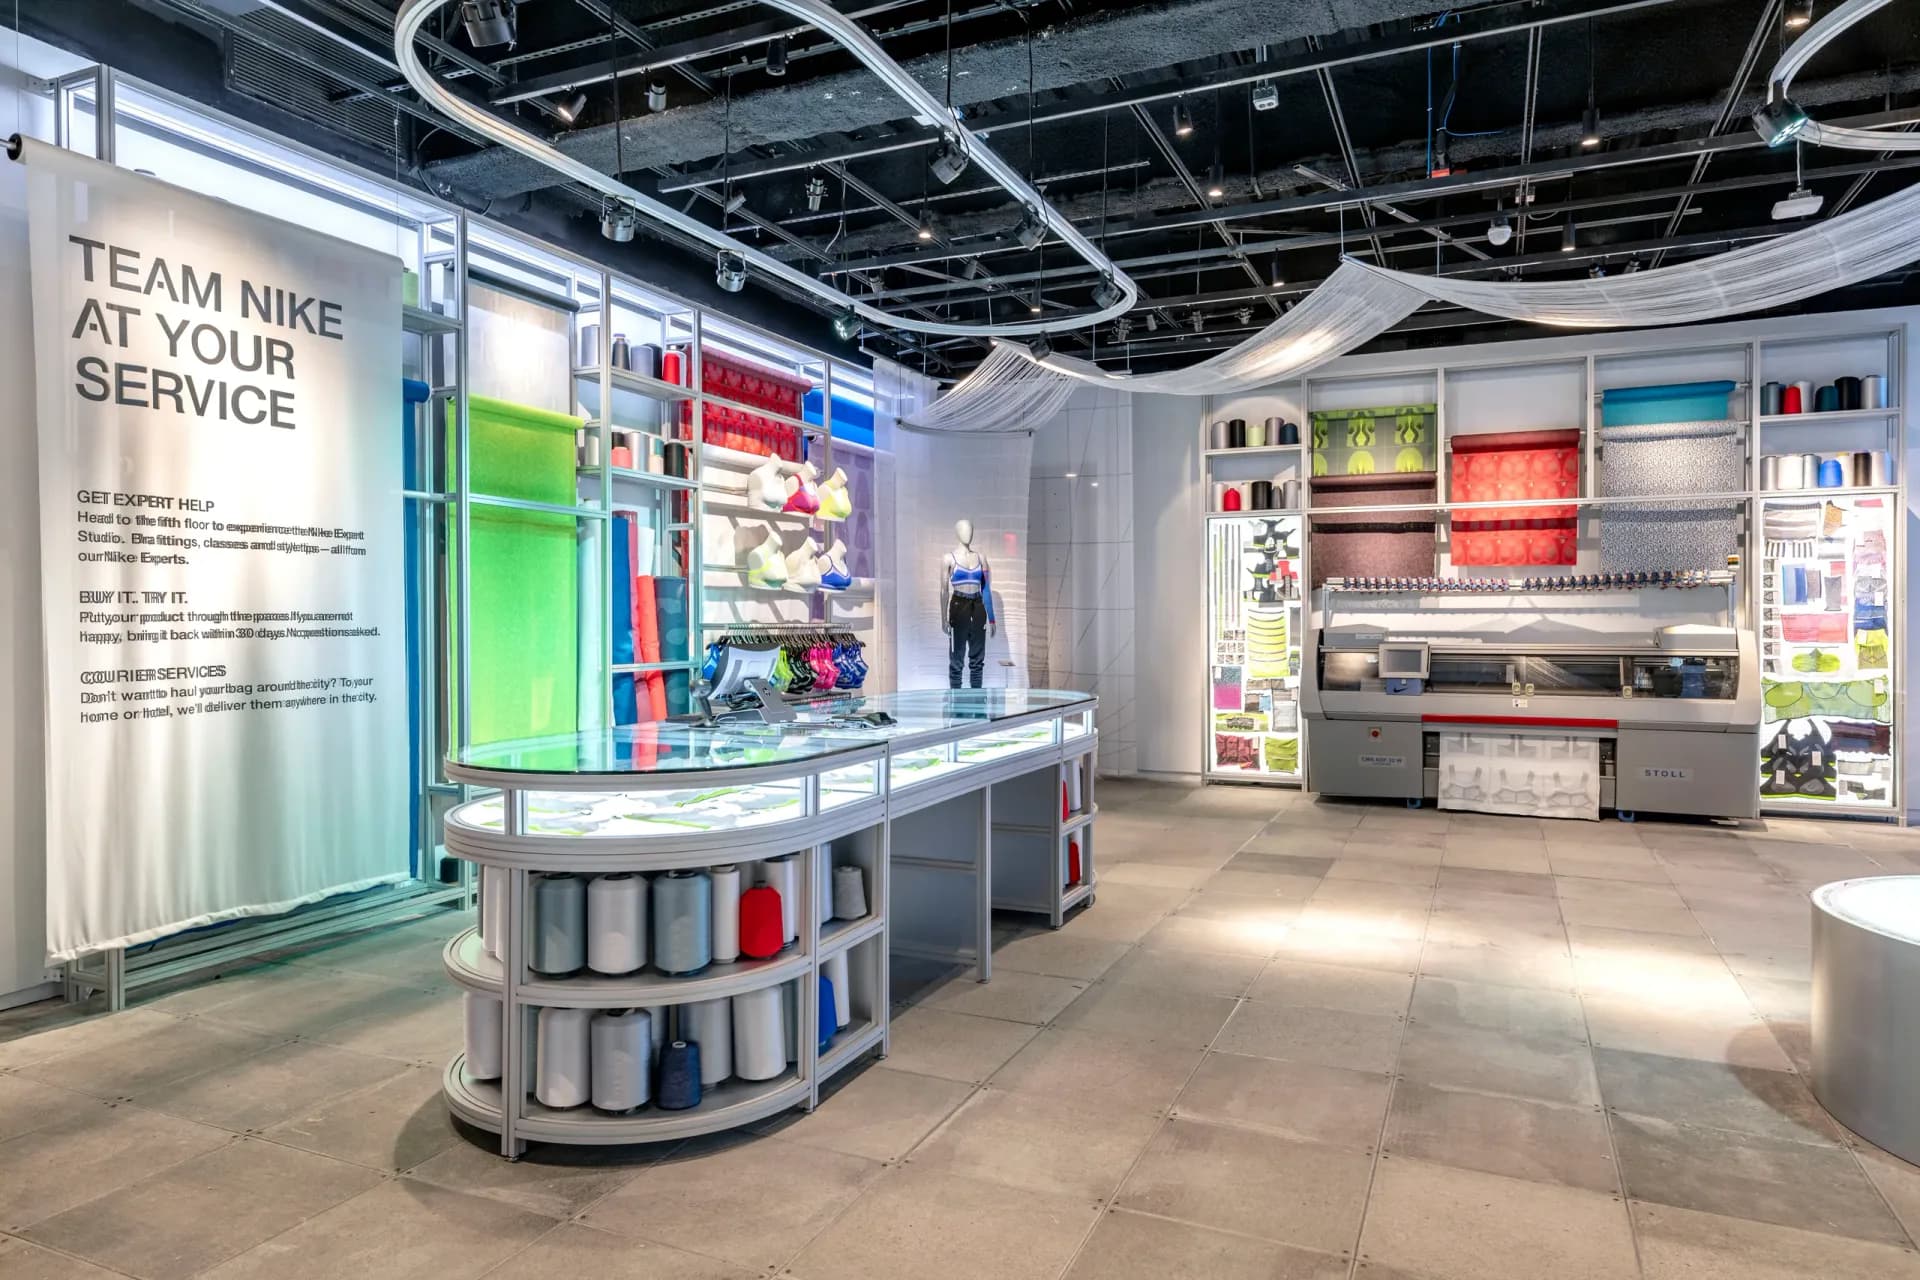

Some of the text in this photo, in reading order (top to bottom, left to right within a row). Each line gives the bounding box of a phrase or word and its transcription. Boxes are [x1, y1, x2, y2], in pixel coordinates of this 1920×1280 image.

[69, 234, 344, 341] TEAM NIKE
[71, 297, 296, 380] AT YOUR
[75, 356, 296, 430] SERVICE
[77, 490, 215, 512] GET EXPERT HELP
[77, 510, 114, 524] Head
[116, 513, 131, 526] to
[135, 514, 157, 527] the
[157, 516, 182, 529] fifth
[184, 518, 210, 530] floor
[212, 520, 225, 531] to
[226, 522, 292, 536] experience
[307, 527, 333, 538] Nike
[333, 528, 364, 541] Expert
[77, 530, 125, 544] Studio.
[131, 533, 156, 546] Bra
[156, 534, 201, 549] fittings,
[203, 537, 249, 550] classes
[250, 541, 276, 551] and
[78, 550, 190, 567] our Nike Experts.
[79, 590, 189, 604] BUY IT. TRY IT.
[79, 611, 105, 624] Put
[103, 613, 139, 626] your
[139, 611, 185, 625] product
[187, 611, 229, 624] through
[230, 611, 253, 622] the
[79, 630, 122, 645] happy,
[127, 630, 159, 643] bring
[159, 630, 168, 640] it
[170, 629, 200, 640] back
[200, 628, 235, 639] within
[235, 628, 254, 638] 30
[80, 665, 226, 684] COURIER SERVICES
[80, 690, 118, 704] Don't
[121, 690, 152, 701] want
[151, 688, 168, 700] to
[170, 685, 197, 698] haul
[199, 684, 227, 699] your
[226, 683, 253, 695] bag
[256, 680, 297, 693] around
[310, 677, 337, 691] city?
[340, 677, 352, 688] To
[352, 677, 374, 689] your
[80, 711, 119, 724] home
[123, 710, 141, 721] or
[177, 703, 203, 716] we'll
[204, 699, 246, 714] deliver
[250, 698, 282, 711] them
[285, 695, 326, 709] anywhere
[329, 693, 339, 704] in
[342, 692, 357, 703] the
[358, 691, 377, 704] city.
[1644, 768, 1686, 778] STOLL
